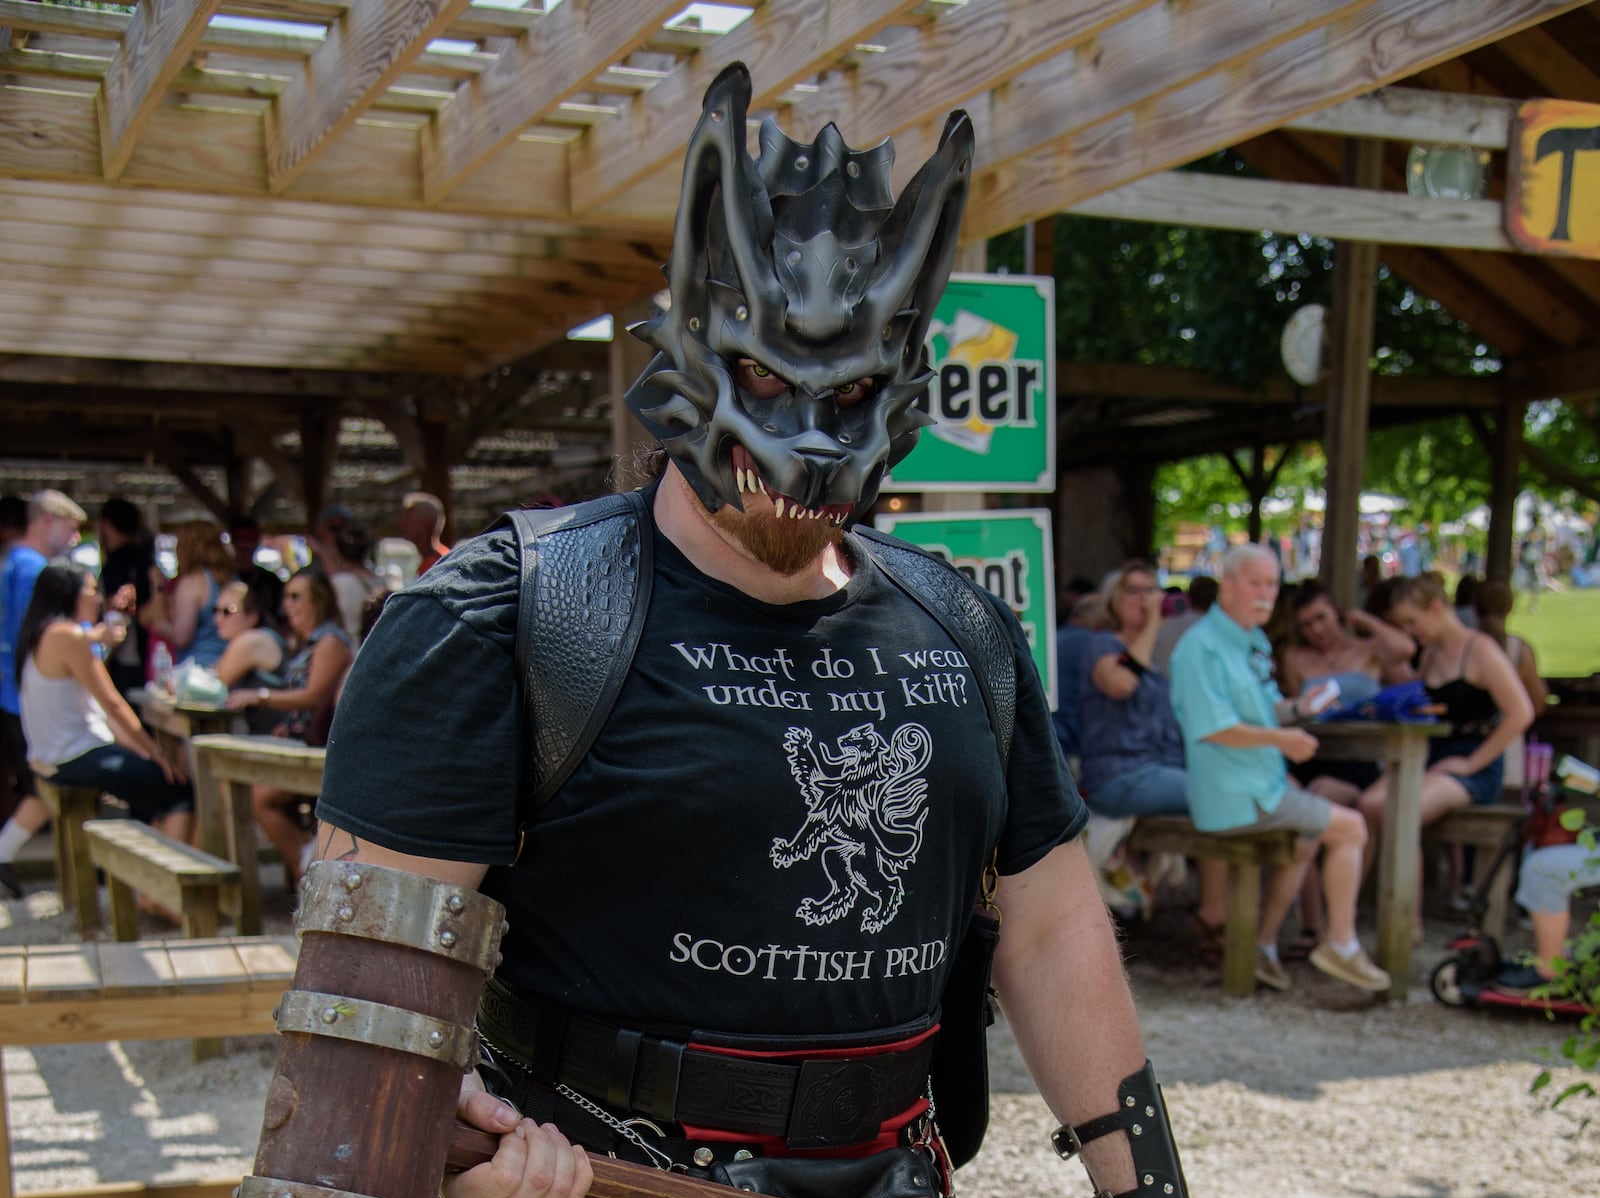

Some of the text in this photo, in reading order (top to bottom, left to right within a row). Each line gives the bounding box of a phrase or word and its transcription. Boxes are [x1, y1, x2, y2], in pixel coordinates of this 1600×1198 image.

[920, 343, 1038, 423] eer
[670, 642, 796, 681] What
[811, 648, 855, 679] do
[866, 647, 888, 675] I
[702, 672, 968, 721] under my kilt?
[669, 932, 876, 982] SCOTTISH
